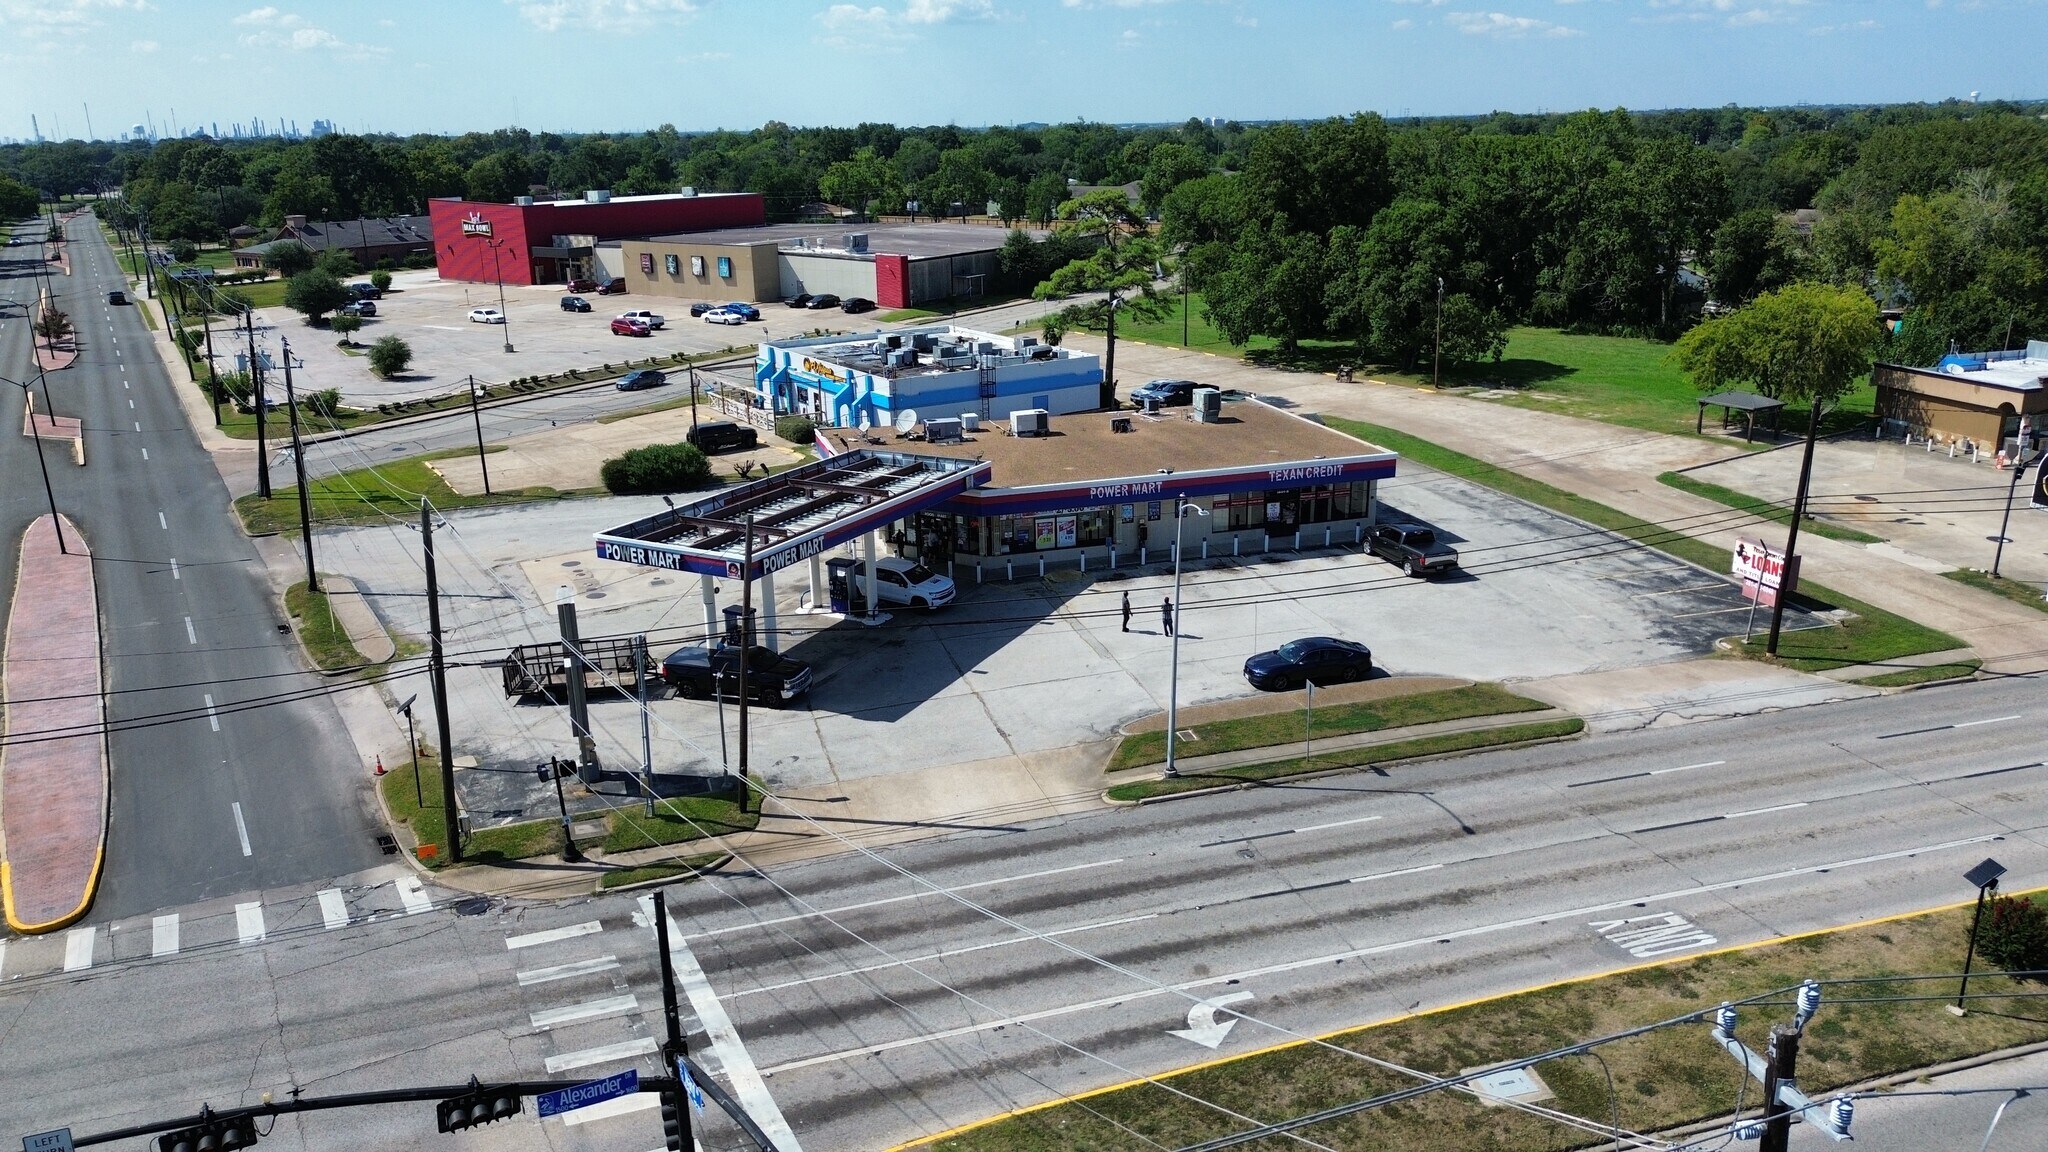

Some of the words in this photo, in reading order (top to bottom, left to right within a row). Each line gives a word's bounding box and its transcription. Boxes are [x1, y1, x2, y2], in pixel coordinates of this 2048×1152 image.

[1269, 469, 1304, 482] TEXAN
[1306, 465, 1344, 478] CREDIT
[1090, 485, 1128, 499] POWER
[1132, 481, 1162, 495] MART
[605, 543, 646, 564] POWER
[648, 550, 680, 570] MART
[763, 544, 798, 575] POWER
[800, 535, 825, 560] MART
[1751, 554, 1785, 577] LOANS
[1750, 571, 1760, 579] TITL
[1588, 911, 1718, 957] ONLY
[625, 1072, 633, 1080] DR
[560, 1076, 623, 1106] Alexander
[626, 1084, 638, 1093] 1600
[555, 1104, 568, 1113] 1500
[34, 1134, 60, 1148] LEFT
